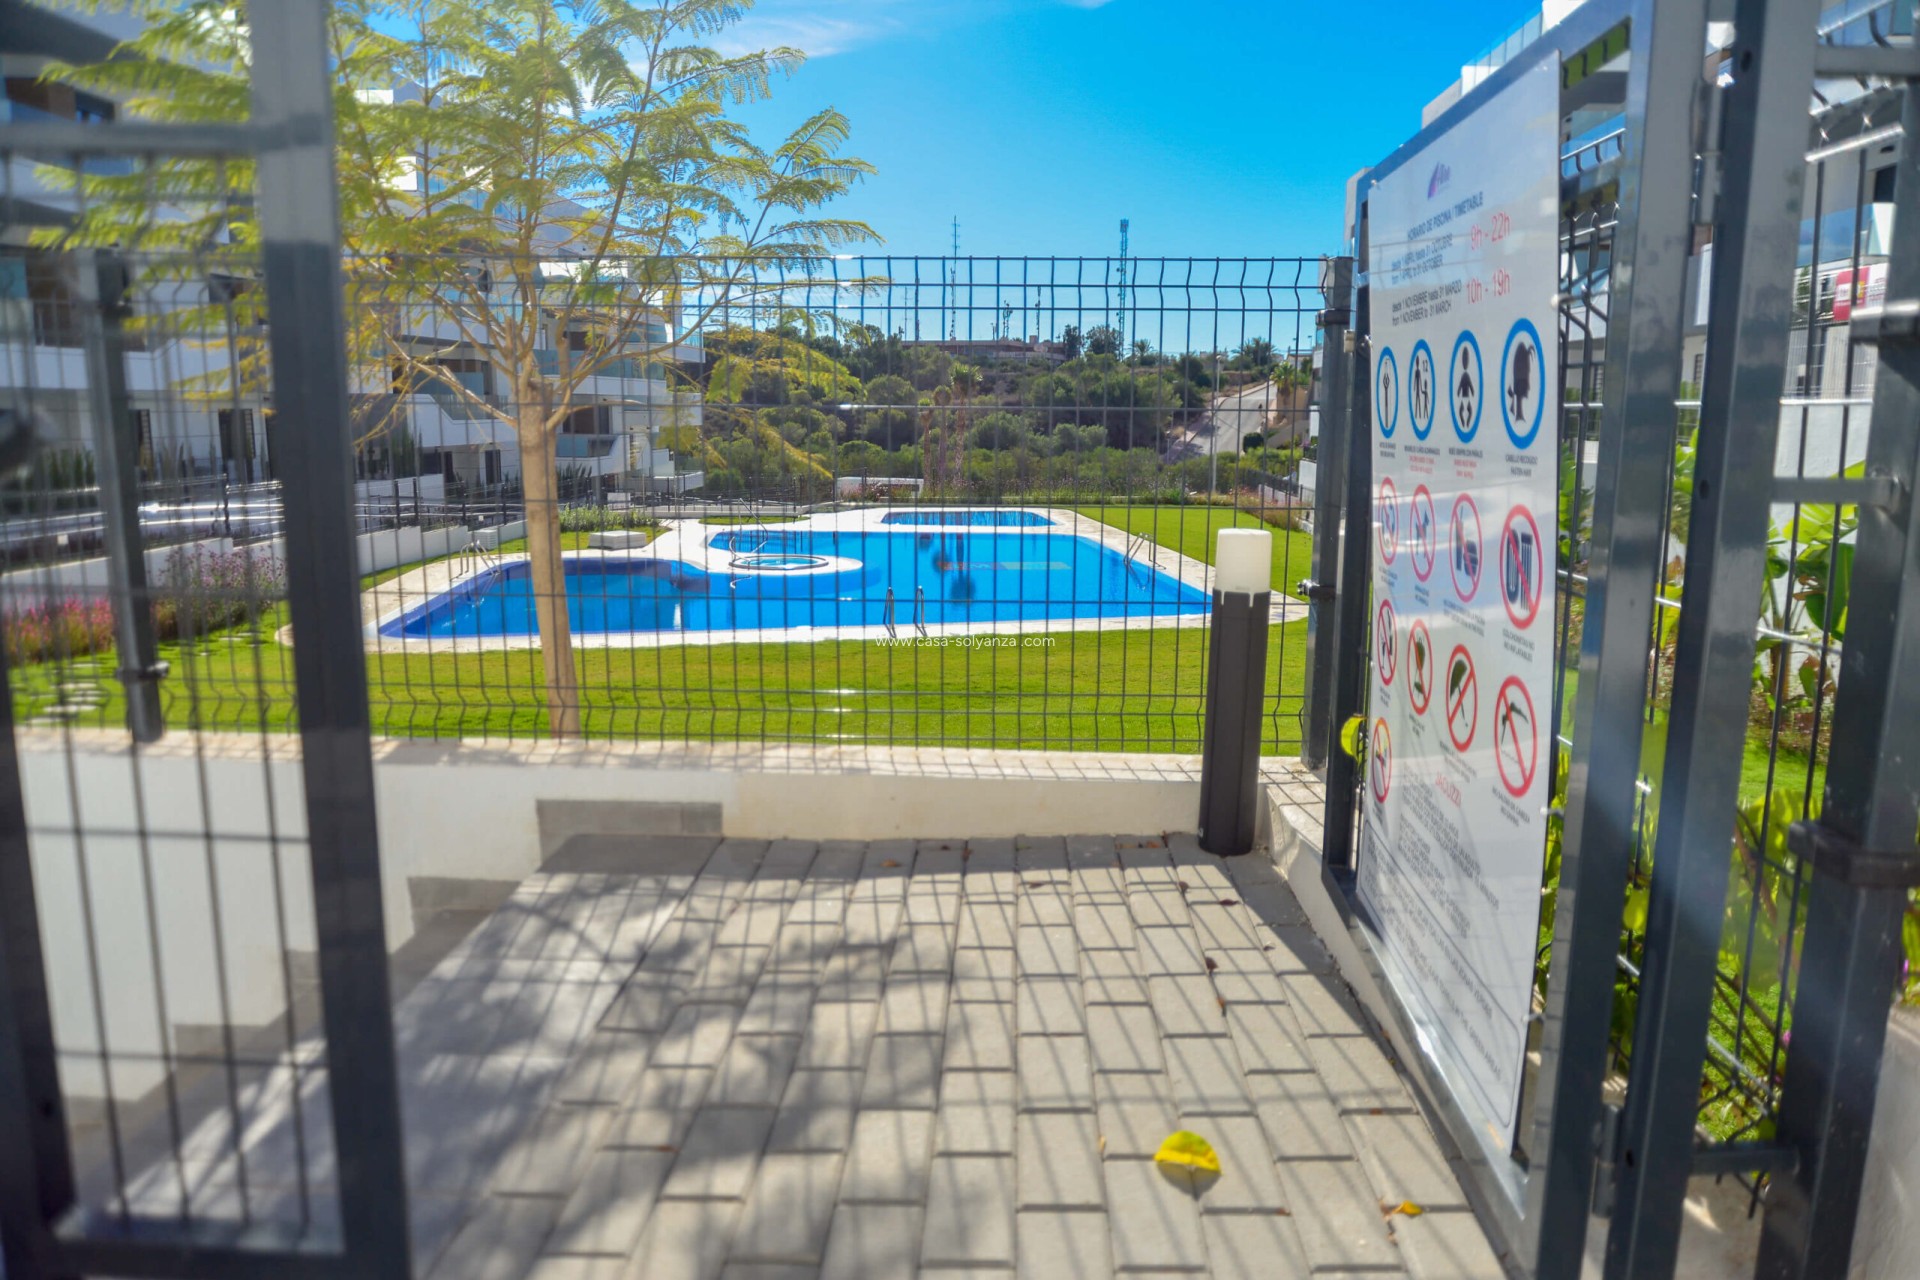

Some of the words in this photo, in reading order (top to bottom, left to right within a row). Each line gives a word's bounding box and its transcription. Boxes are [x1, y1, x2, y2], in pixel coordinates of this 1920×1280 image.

[1491, 211, 1511, 242] 22h
[1467, 277, 1482, 304] 10h
[1493, 269, 1511, 297] 19h
